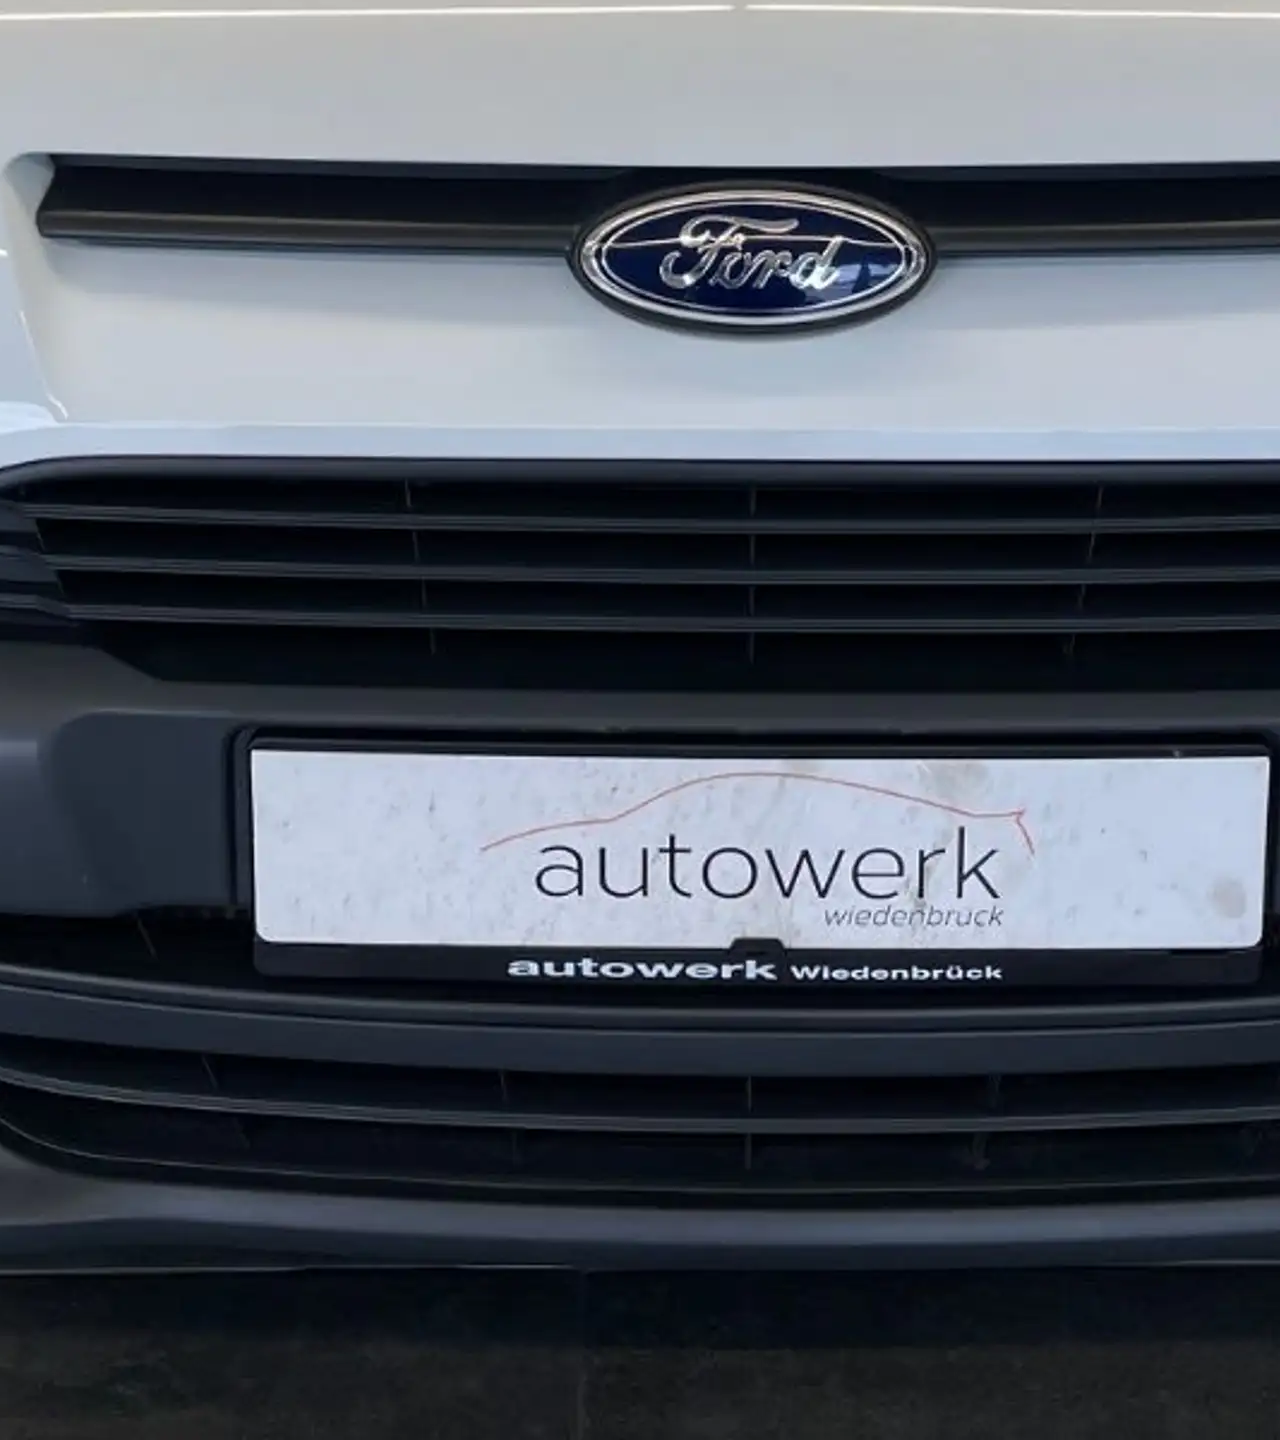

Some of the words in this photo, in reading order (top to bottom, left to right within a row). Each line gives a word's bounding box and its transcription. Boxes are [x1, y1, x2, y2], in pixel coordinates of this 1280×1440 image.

[658, 214, 841, 291] Ford
[534, 825, 1001, 900] autowerk
[507, 956, 778, 981] autowerk
[790, 964, 1003, 981] Wiedenbrück
